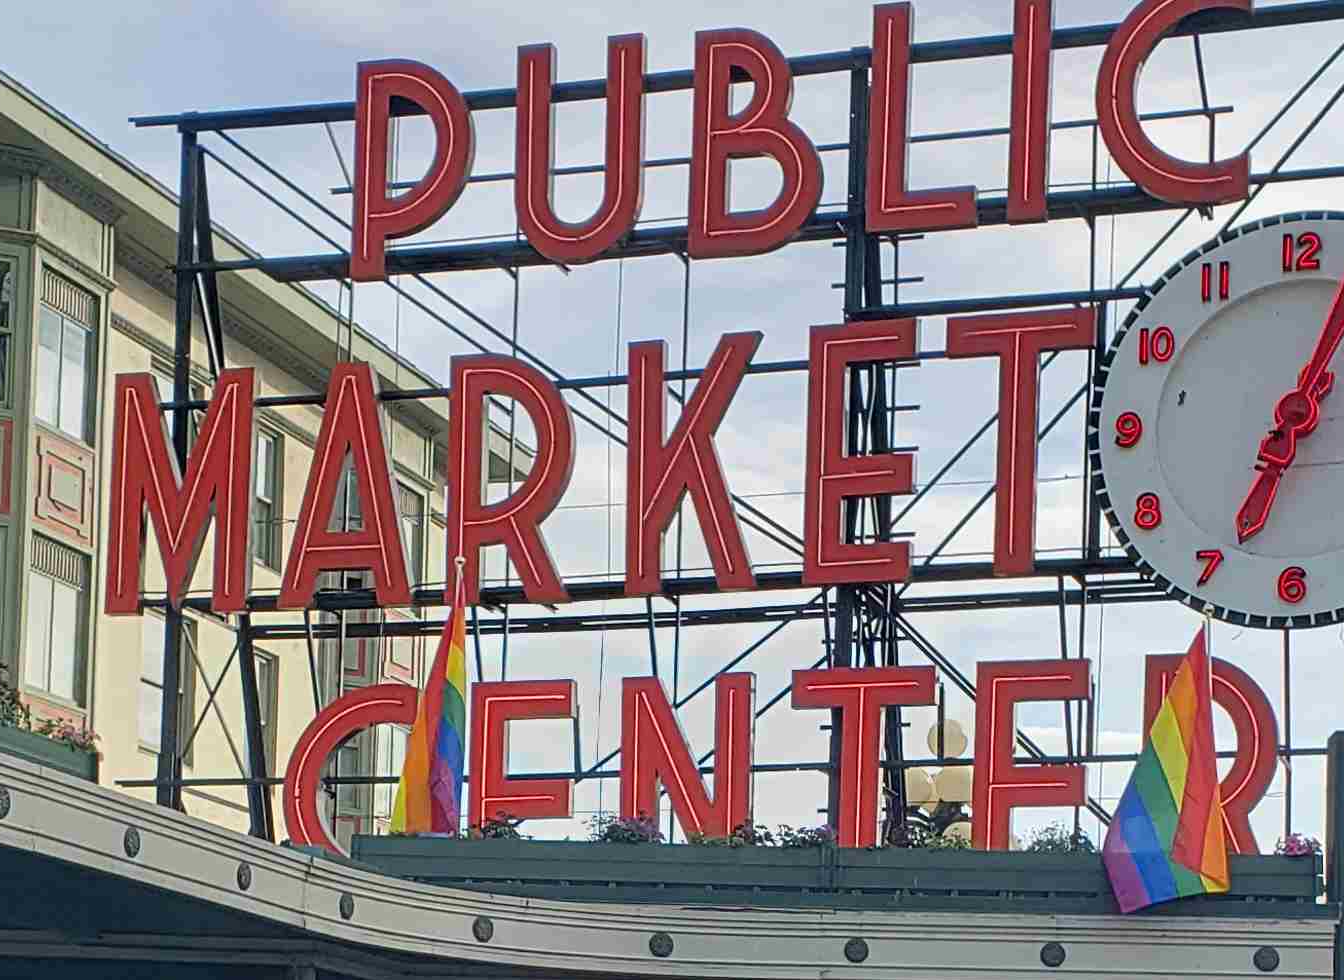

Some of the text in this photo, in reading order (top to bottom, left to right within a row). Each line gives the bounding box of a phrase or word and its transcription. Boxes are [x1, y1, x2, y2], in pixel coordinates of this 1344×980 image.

[350, 0, 1253, 281] PUBLIC
[1282, 231, 1322, 272] 12
[1201, 261, 1230, 302] 11
[1138, 326, 1175, 365] 10
[1114, 411, 1144, 448] 9
[104, 305, 1099, 614] MARKET
[1134, 492, 1162, 529] 8
[1195, 548, 1224, 586] 7
[1277, 566, 1306, 603] 6
[283, 653, 1280, 857] CENTER
